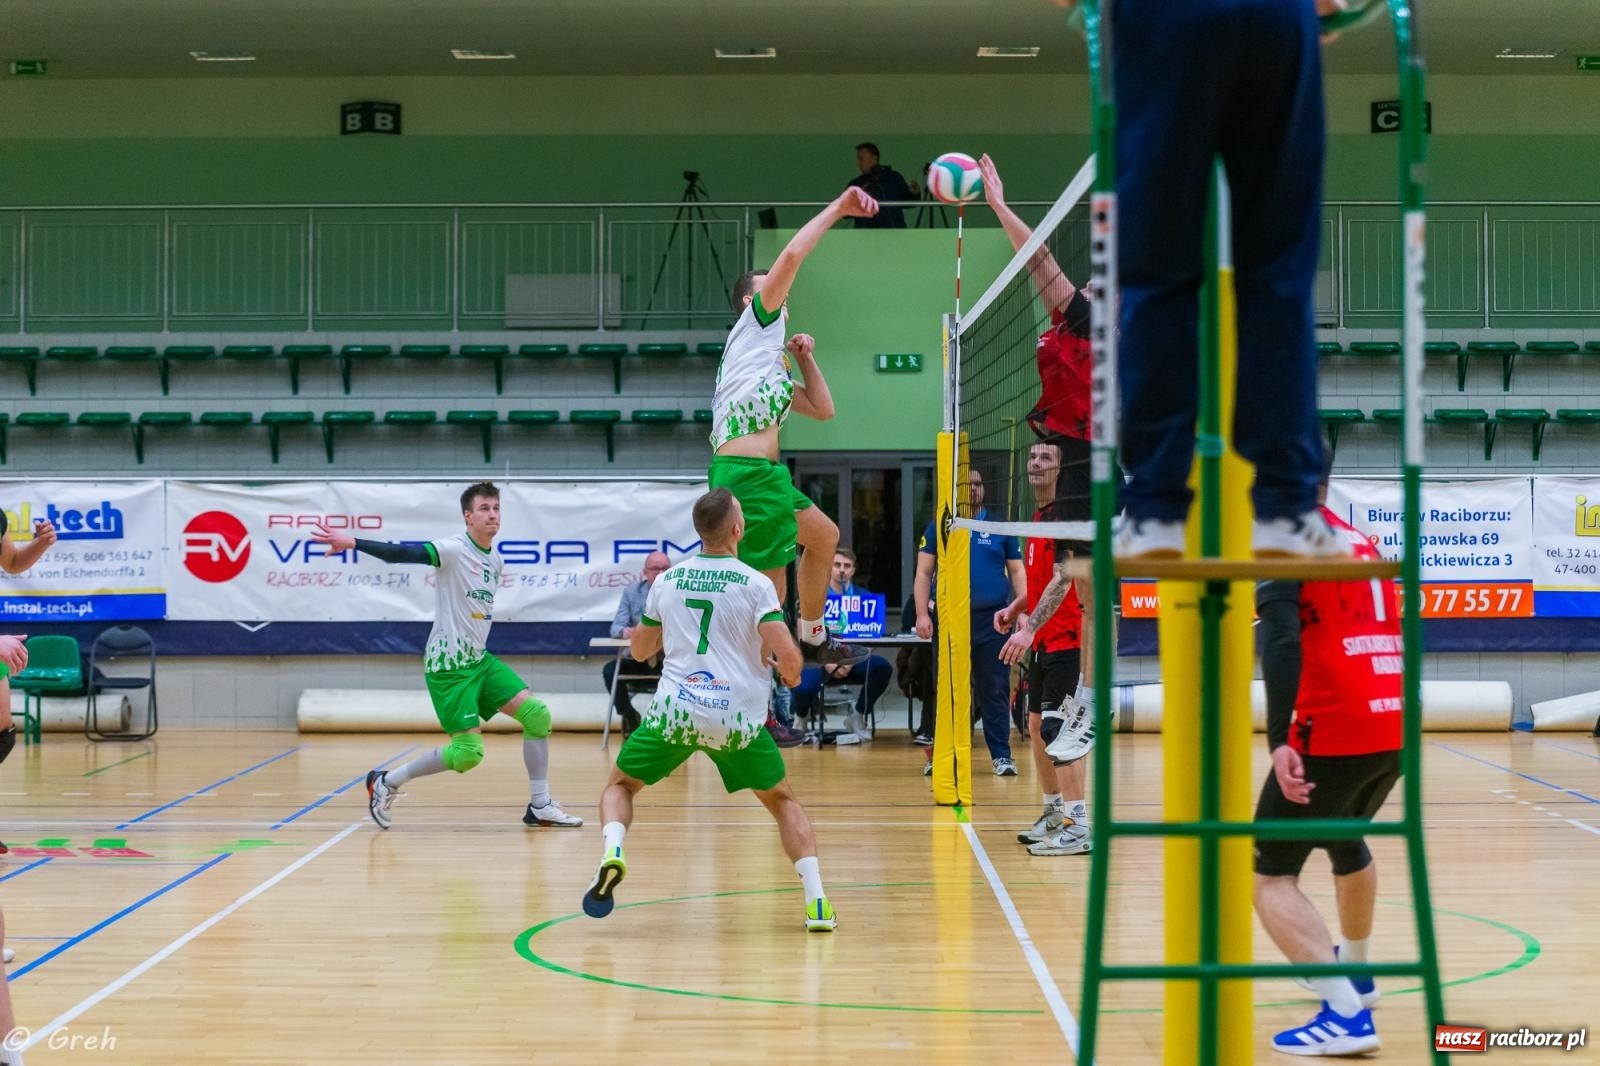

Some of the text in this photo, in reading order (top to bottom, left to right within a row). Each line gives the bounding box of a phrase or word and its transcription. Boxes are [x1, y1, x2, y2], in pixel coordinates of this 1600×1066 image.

[346, 113, 361, 131] B
[375, 112, 394, 130] B
[1377, 110, 1399, 129] C
[269, 515, 382, 530] RADIO
[1430, 509, 1511, 522] Raciborzu:
[1383, 532, 1499, 550] ul. pawska 69
[84, 552, 105, 561] 606
[110, 551, 128, 561] 363
[132, 551, 152, 560] 647
[1028, 543, 1035, 566] 9
[1419, 554, 1513, 567] ickiewicza 3
[1546, 547, 1600, 558] tel. 32 41
[39, 571, 60, 579] von
[64, 567, 135, 578] Eichendorffa
[139, 567, 145, 577] 2
[687, 569, 750, 586] SIATKARSKI
[1554, 564, 1596, 574] 47-400
[824, 599, 840, 618] 24
[862, 599, 877, 619] 17
[1431, 588, 1459, 613] 77
[1463, 588, 1490, 612] 55
[1496, 588, 1523, 612] 77
[685, 598, 714, 655] 7
[847, 622, 882, 635] utterfly
